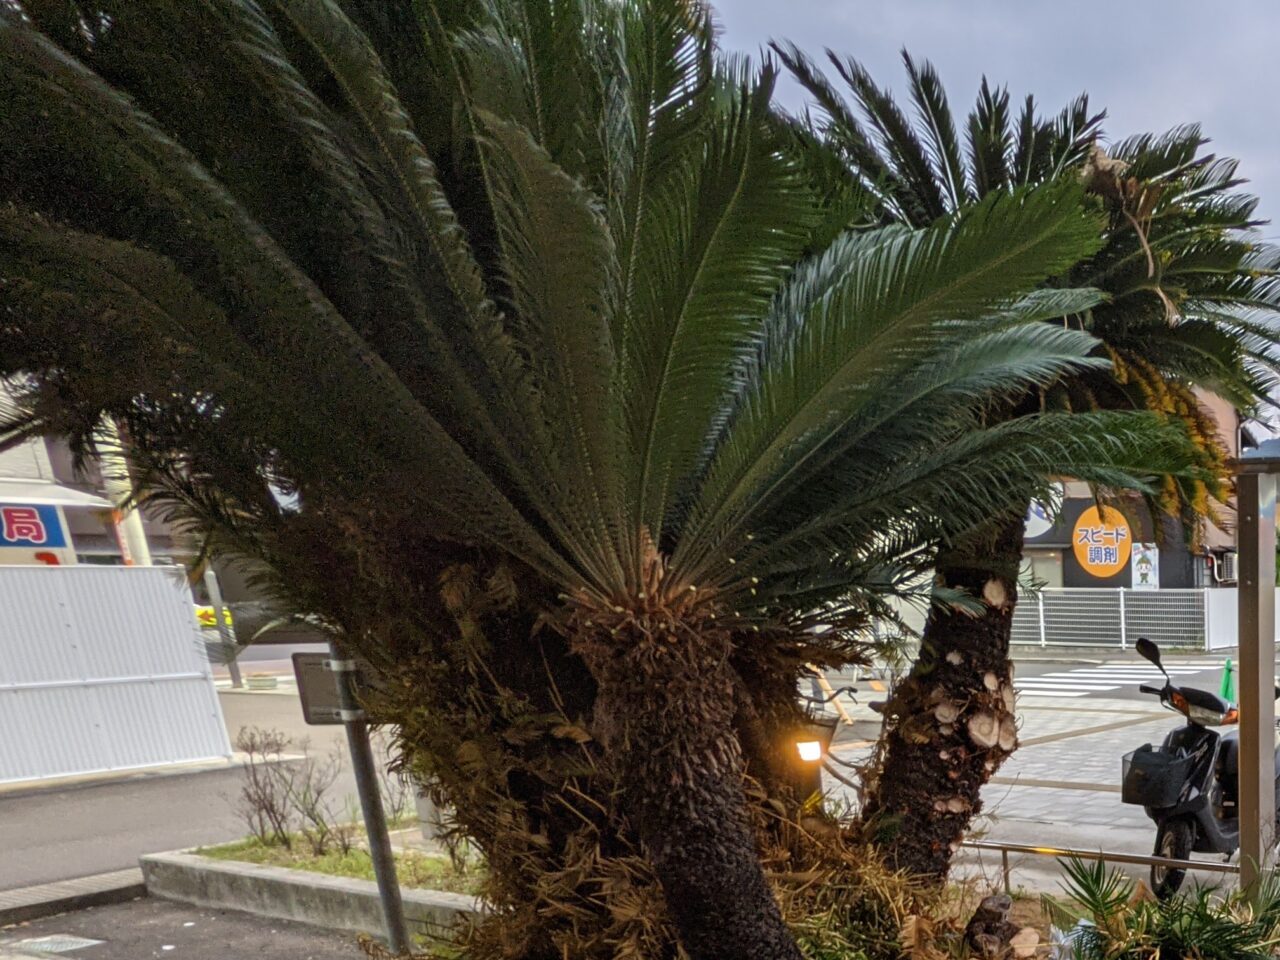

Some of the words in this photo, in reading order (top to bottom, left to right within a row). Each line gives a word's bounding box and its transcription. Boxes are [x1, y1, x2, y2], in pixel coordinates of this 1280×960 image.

[1, 507, 47, 543] 局
[1078, 526, 1126, 544] スピード
[1088, 546, 1118, 564] 調剤
